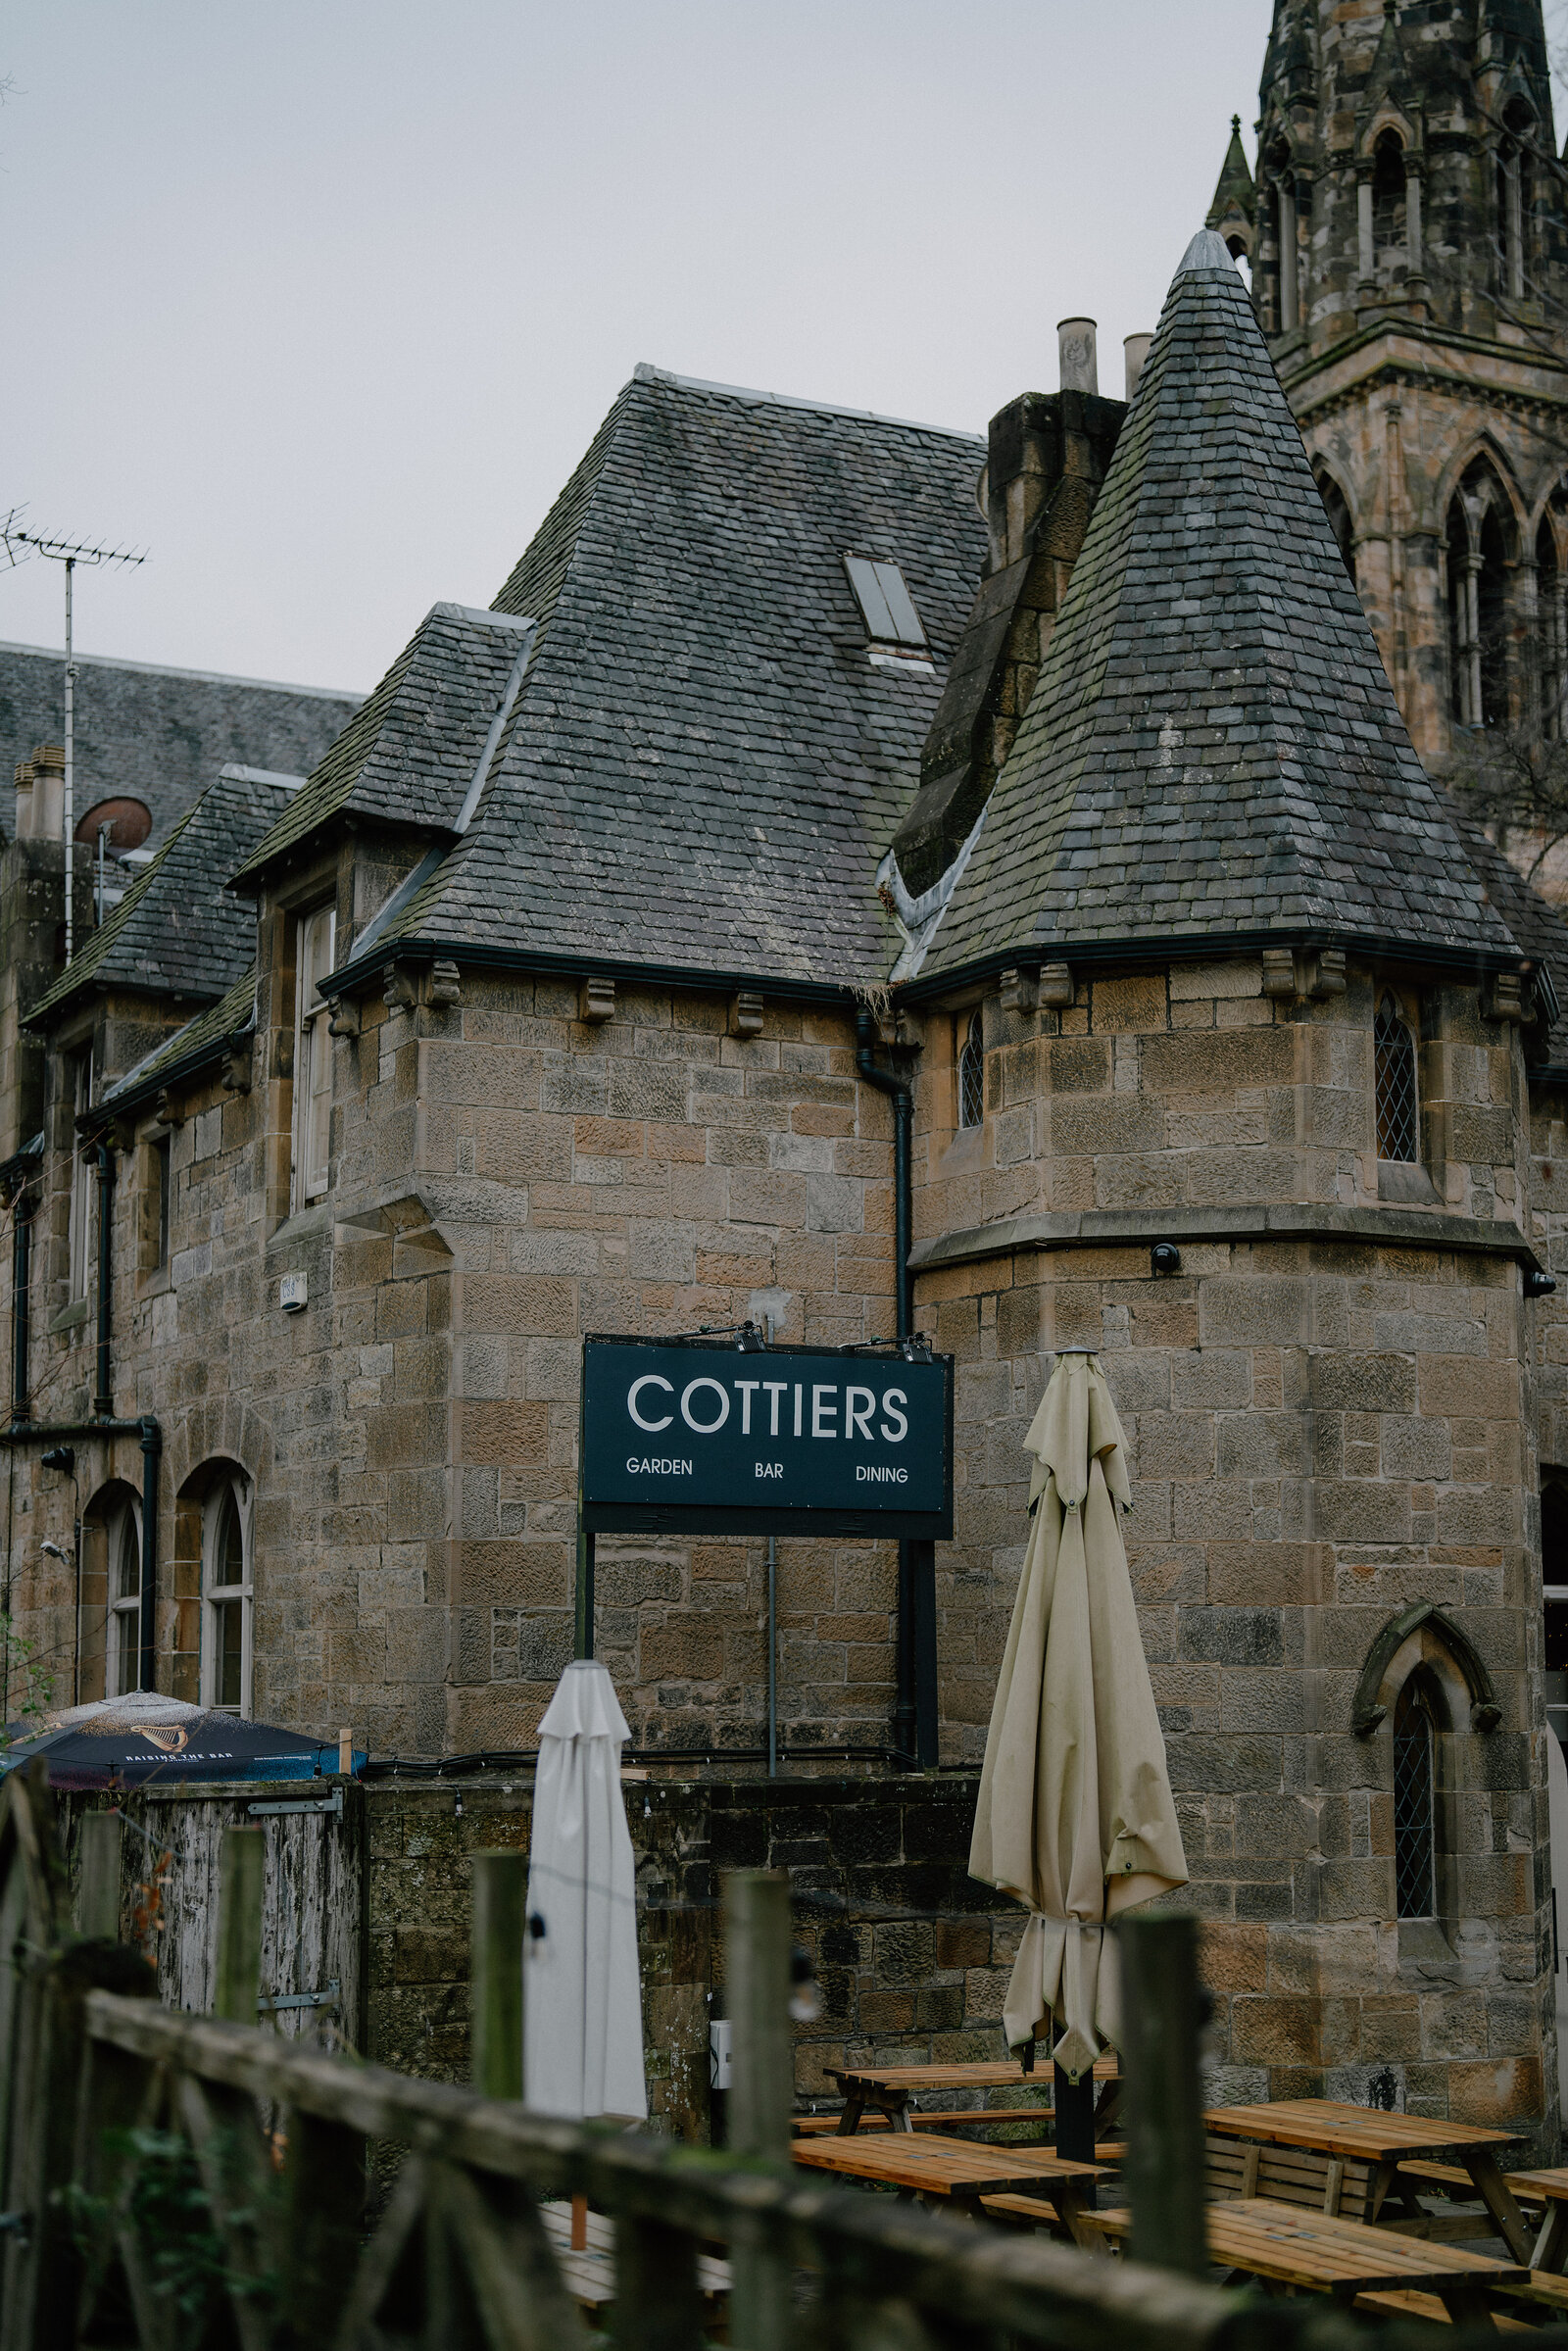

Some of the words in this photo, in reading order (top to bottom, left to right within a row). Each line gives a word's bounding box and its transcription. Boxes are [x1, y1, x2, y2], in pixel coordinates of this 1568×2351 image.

[626, 1373, 909, 1443] COTTIERS
[625, 1456, 693, 1476] GARDEN
[754, 1462, 784, 1479] BAR
[856, 1465, 909, 1484] DINING
